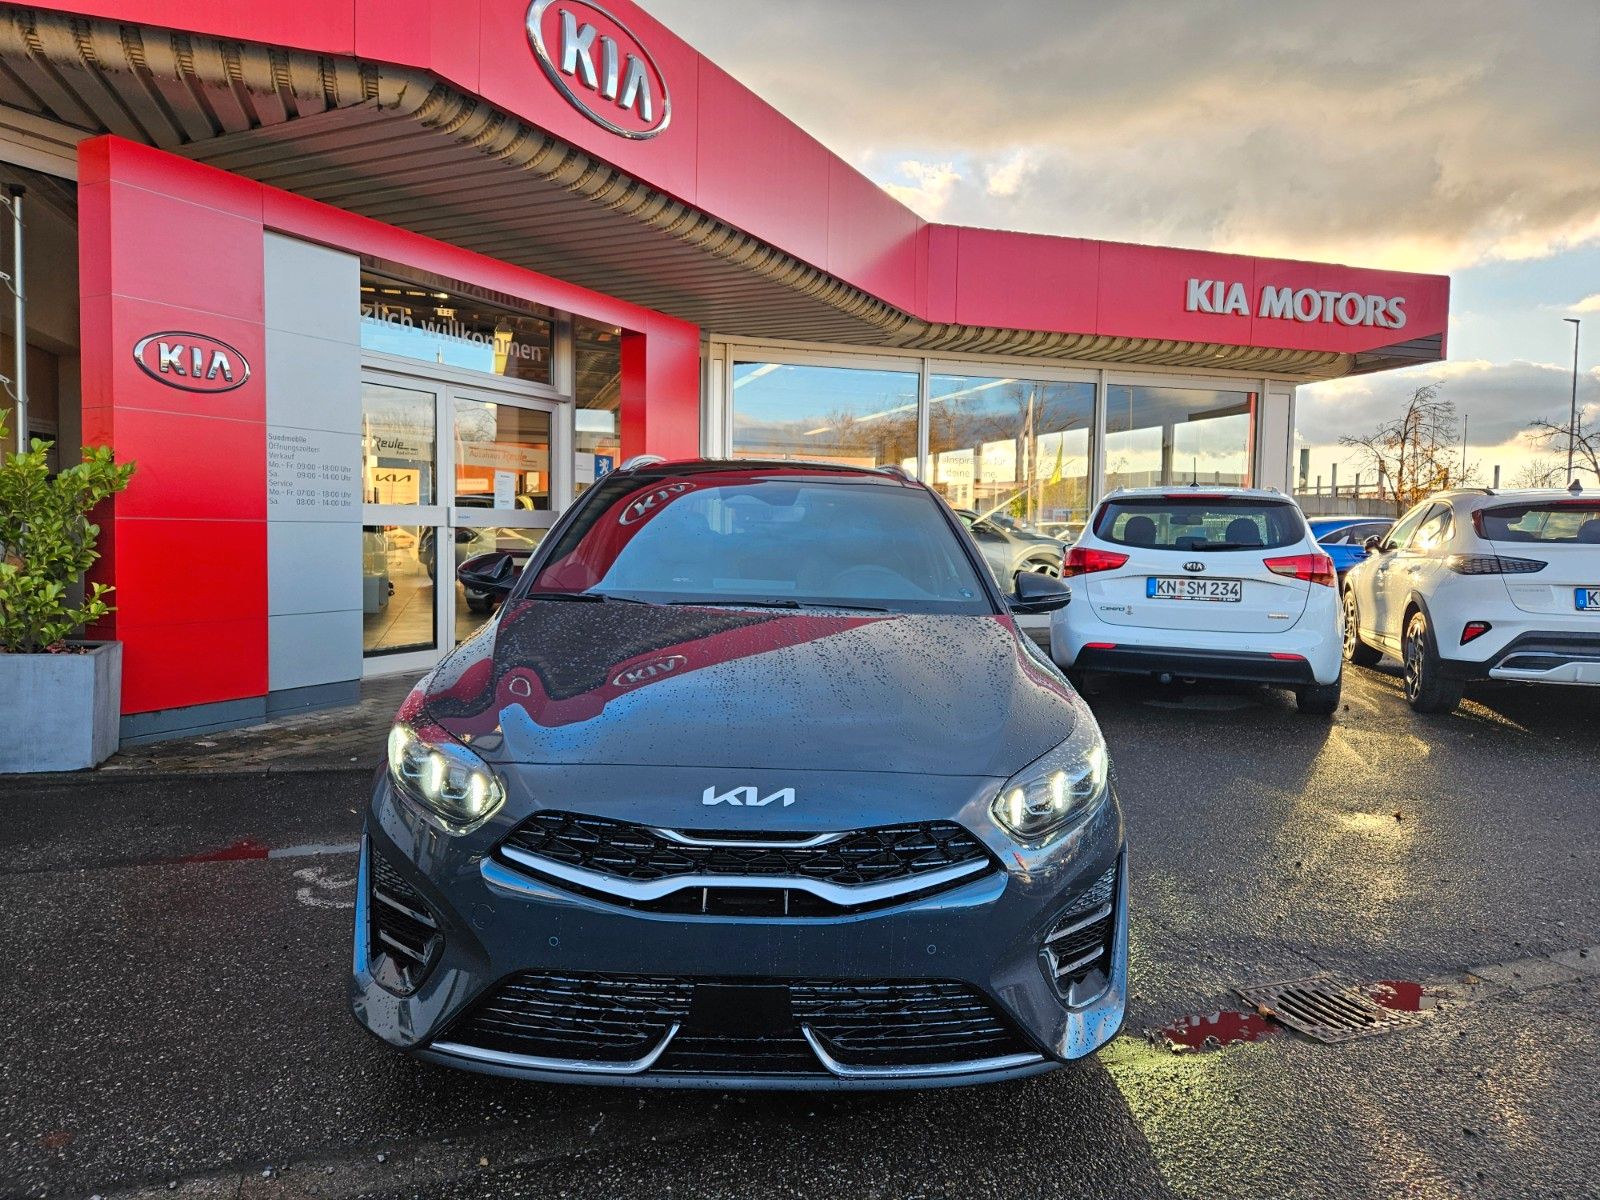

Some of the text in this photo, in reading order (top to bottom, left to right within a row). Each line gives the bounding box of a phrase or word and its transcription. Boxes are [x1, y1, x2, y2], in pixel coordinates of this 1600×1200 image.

[559, 9, 652, 122] KIA
[1186, 278, 1407, 329] KIA MOTORS
[421, 315, 542, 362] willkommen
[158, 342, 233, 381] KIA
[268, 452, 295, 460] Verkauf
[376, 474, 411, 482] KIA
[1157, 580, 1239, 597] KN SM 234
[702, 785, 796, 807] KIA
